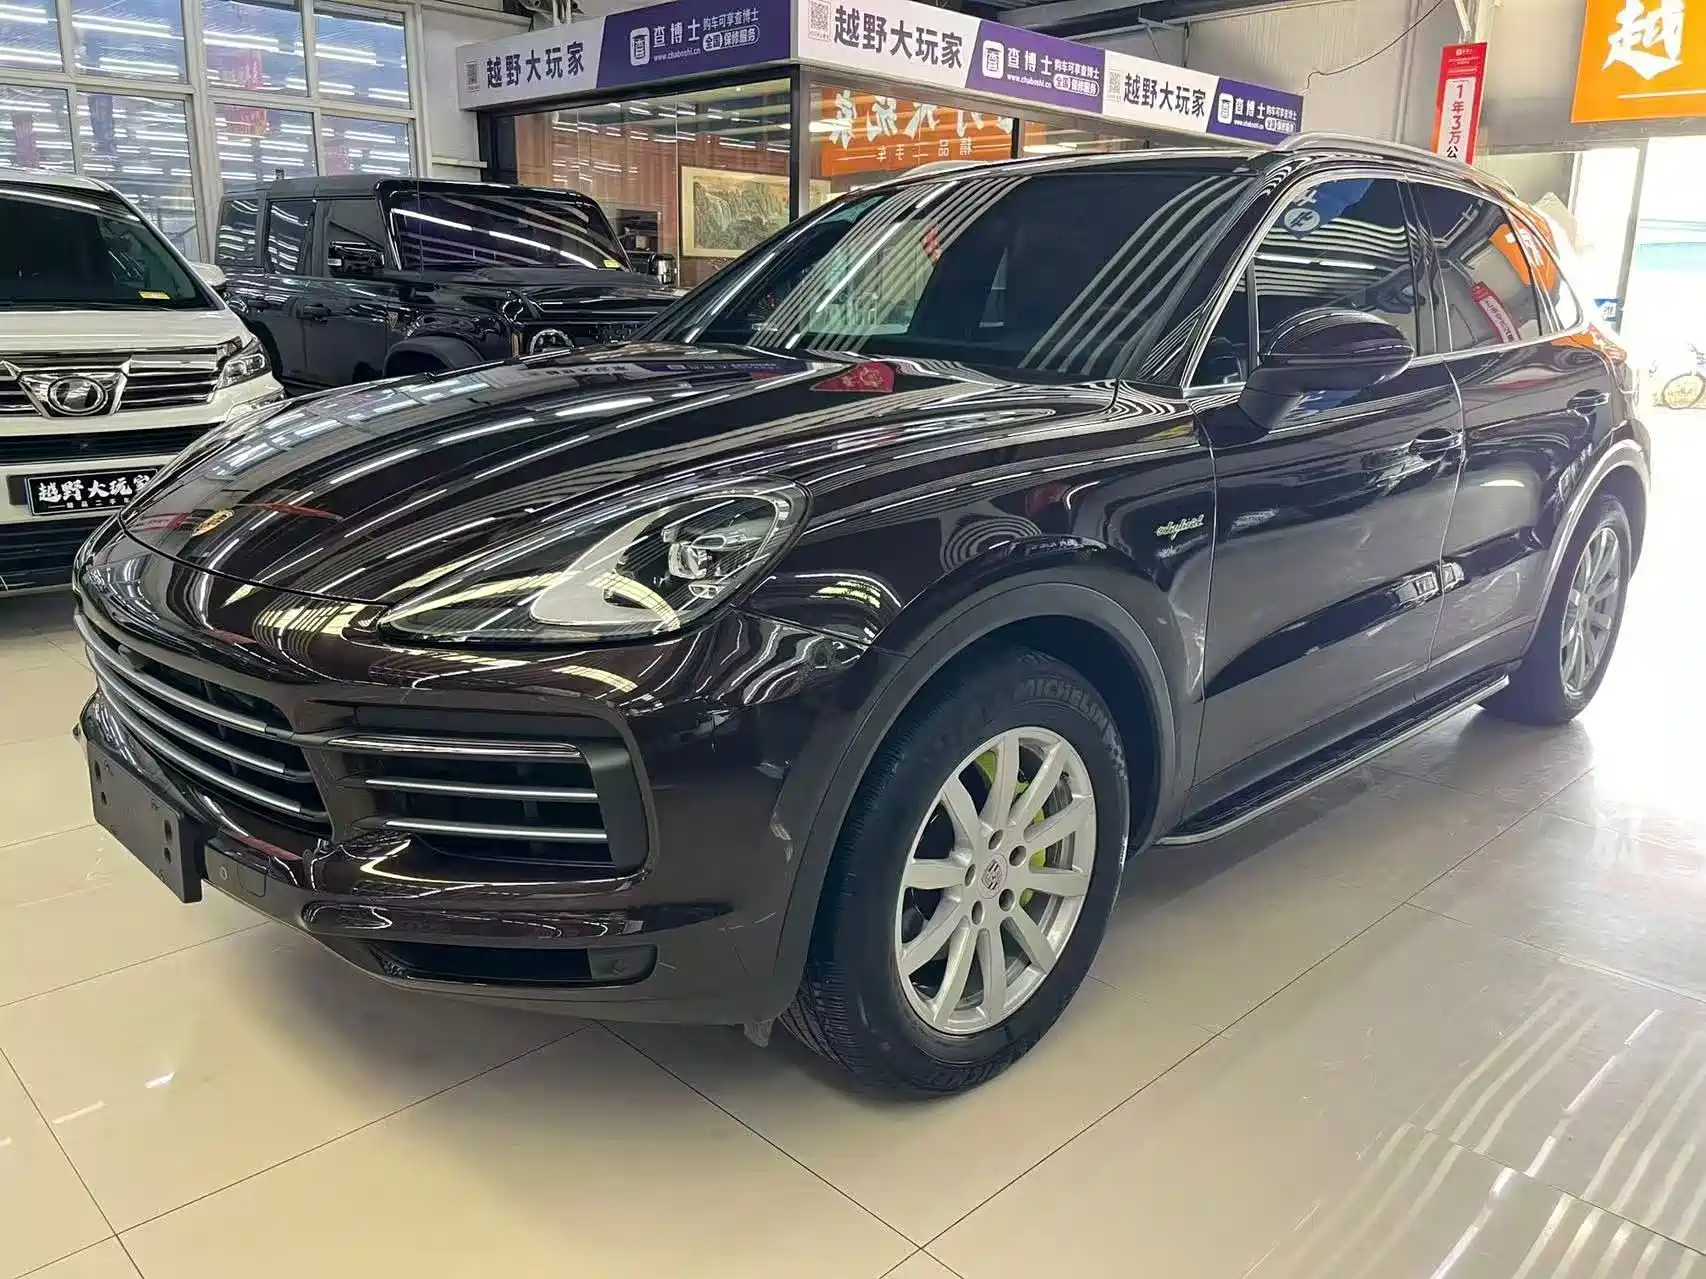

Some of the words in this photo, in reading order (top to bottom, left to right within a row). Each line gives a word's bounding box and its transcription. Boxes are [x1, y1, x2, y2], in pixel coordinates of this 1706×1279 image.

[653, 18, 700, 48] 查博士
[703, 8, 759, 31] 购车可享查博士
[834, 5, 963, 69] 越野大玩家
[487, 41, 585, 89] 越野大玩家
[653, 48, 701, 62] www.chaboshi.cn
[1007, 47, 1053, 76] 查博士
[1123, 72, 1206, 117] 越野大玩家
[1015, 679, 1110, 735] MICHELIN
